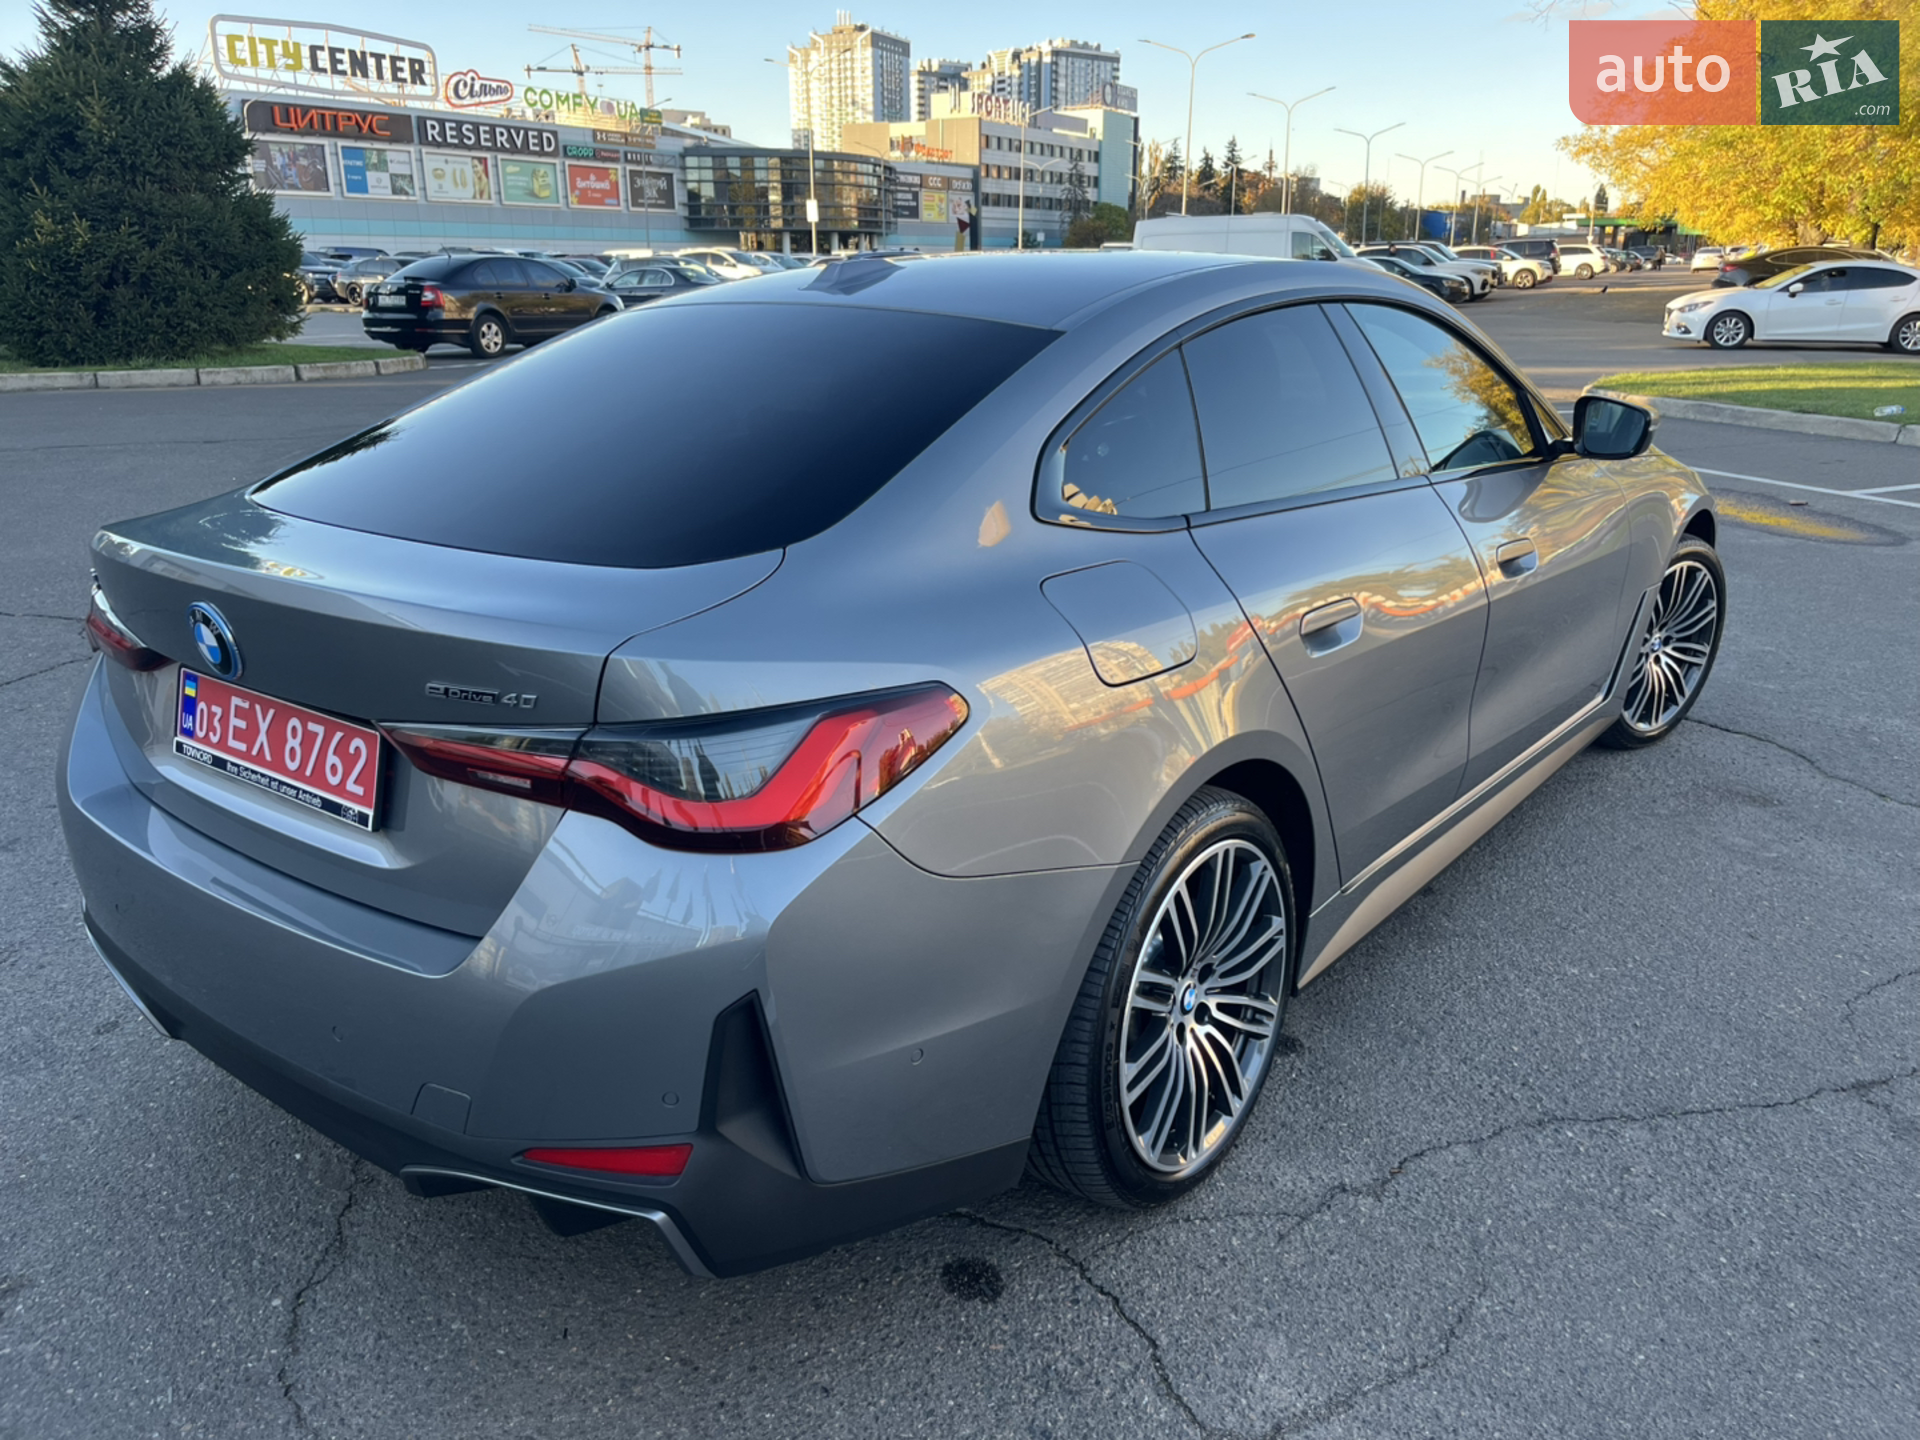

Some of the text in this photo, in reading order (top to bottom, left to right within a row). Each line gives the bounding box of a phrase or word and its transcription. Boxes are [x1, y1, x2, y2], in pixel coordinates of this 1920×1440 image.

[226, 34, 427, 86] CITY CENTER
[453, 75, 511, 100] Сільпо
[271, 105, 391, 136] ЦИТРУС
[425, 119, 556, 152] RESERVED
[566, 146, 594, 158] CROPP
[928, 176, 942, 187] CCC
[501, 693, 538, 708] 40
[182, 712, 194, 731] UA
[195, 695, 368, 797] 03 EX 8762
[226, 761, 238, 775] Ihre
[239, 767, 270, 787] Sicherheit
[270, 779, 279, 790] ist
[279, 784, 298, 799] unser
[298, 790, 323, 808] Antrieb
